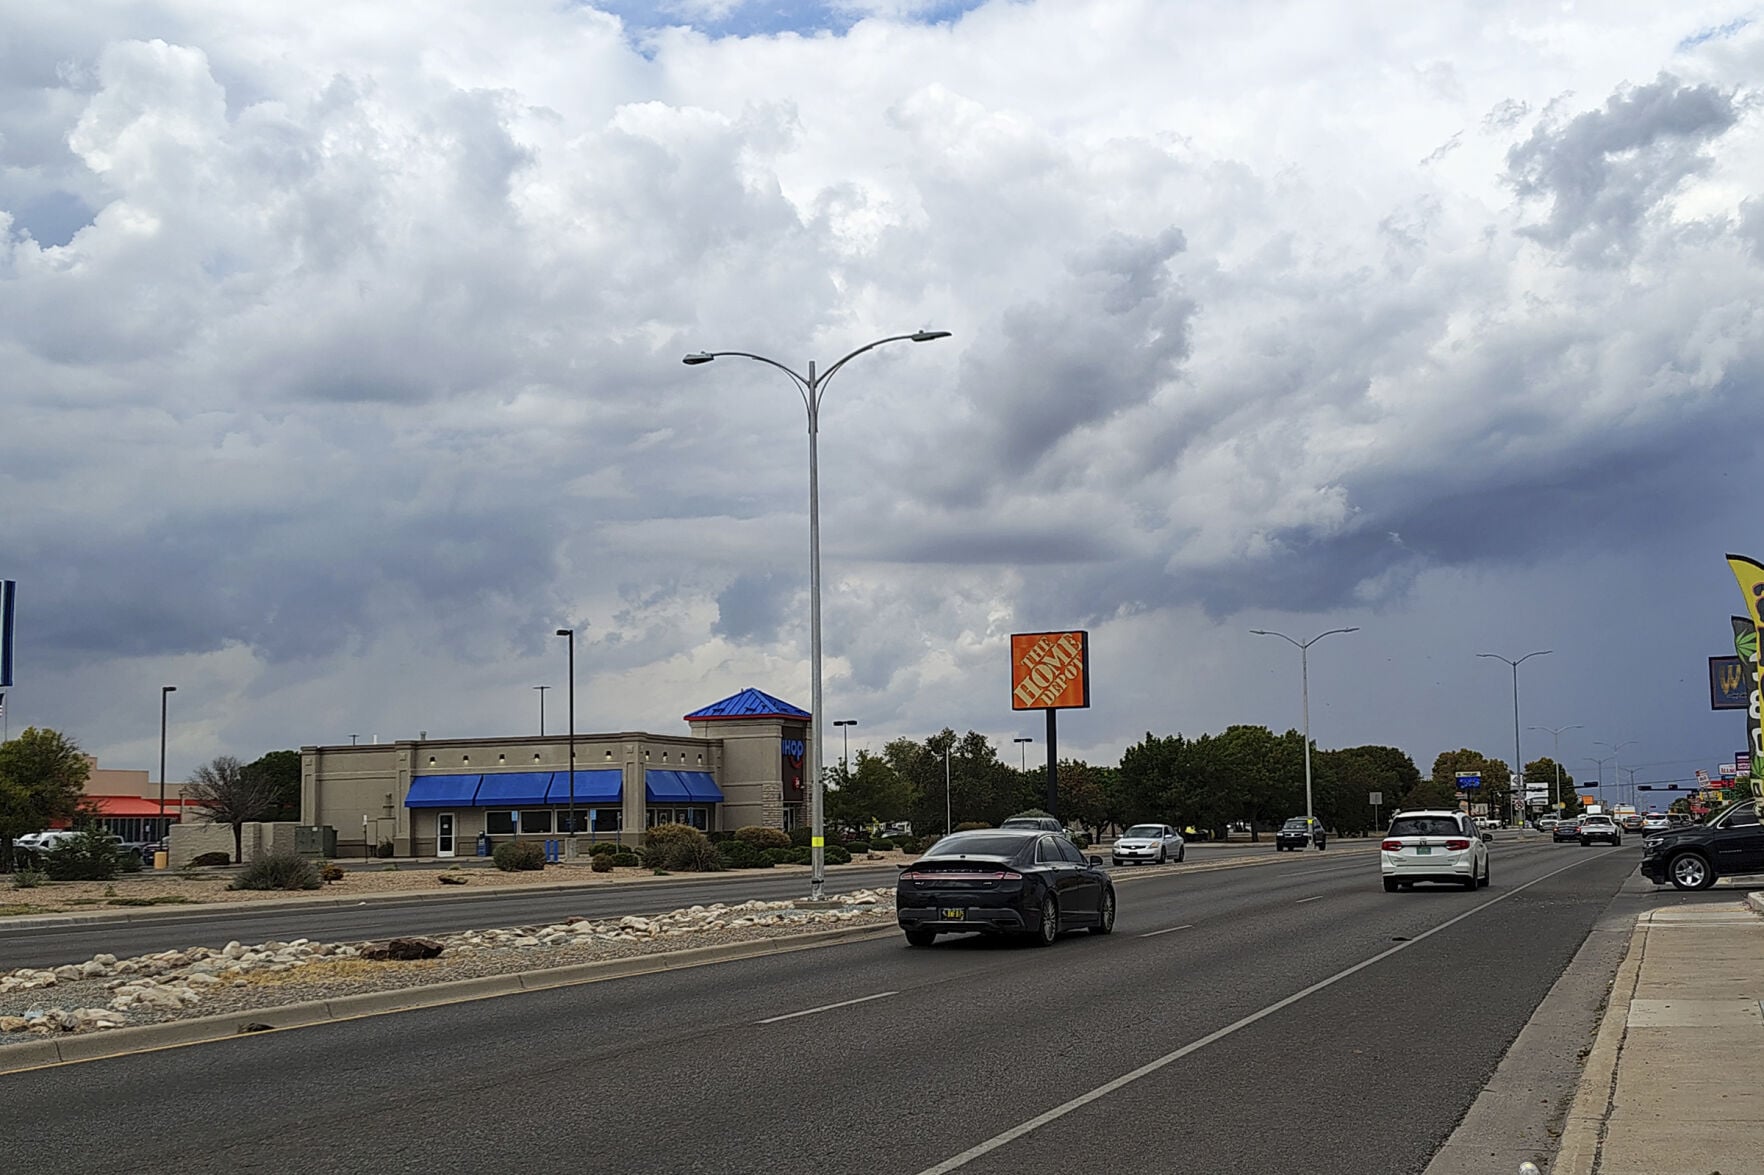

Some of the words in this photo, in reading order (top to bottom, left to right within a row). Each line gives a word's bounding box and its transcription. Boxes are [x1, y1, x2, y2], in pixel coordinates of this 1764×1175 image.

[1013, 633, 1082, 707] HOME
[1020, 636, 1054, 669] THE
[1039, 655, 1083, 706] DEPOT
